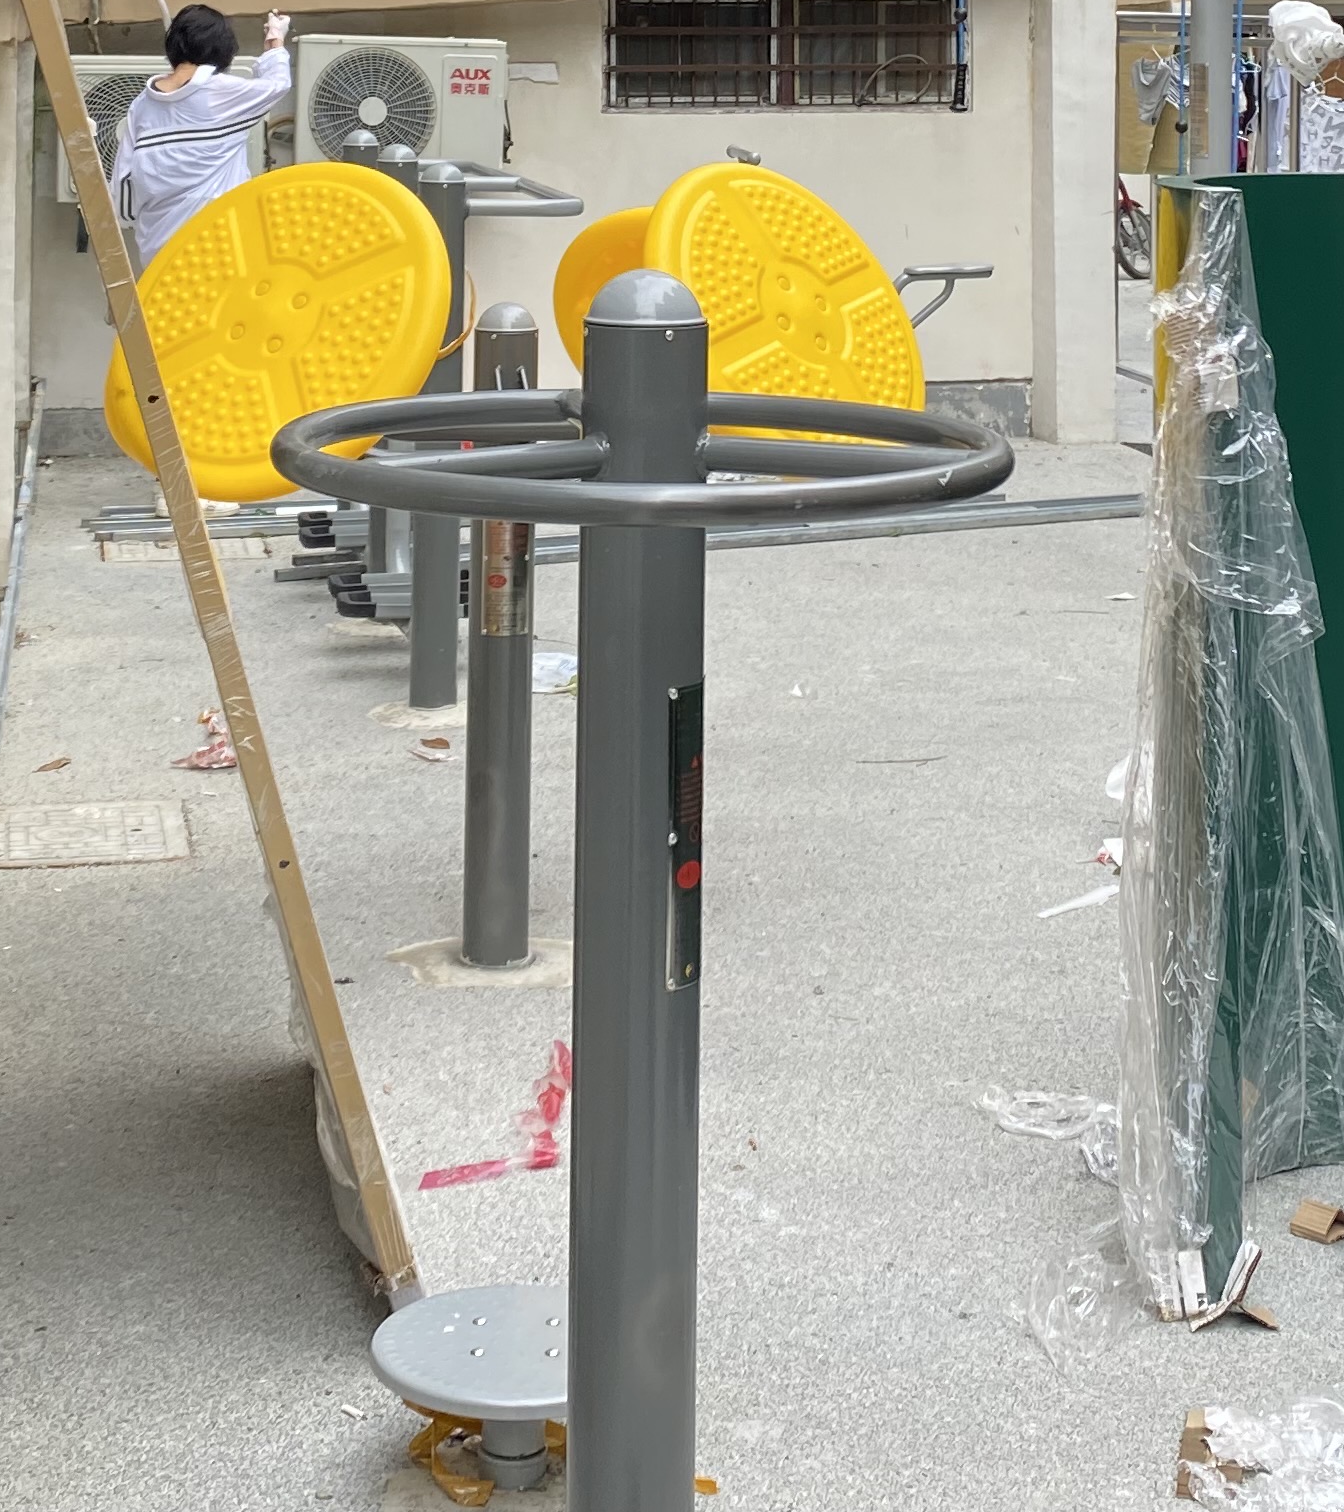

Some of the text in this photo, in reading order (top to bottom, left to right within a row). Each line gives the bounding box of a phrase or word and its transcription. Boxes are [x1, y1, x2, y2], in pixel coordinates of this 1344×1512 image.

[449, 68, 492, 80] AUX
[450, 82, 490, 95] 奥克斯
